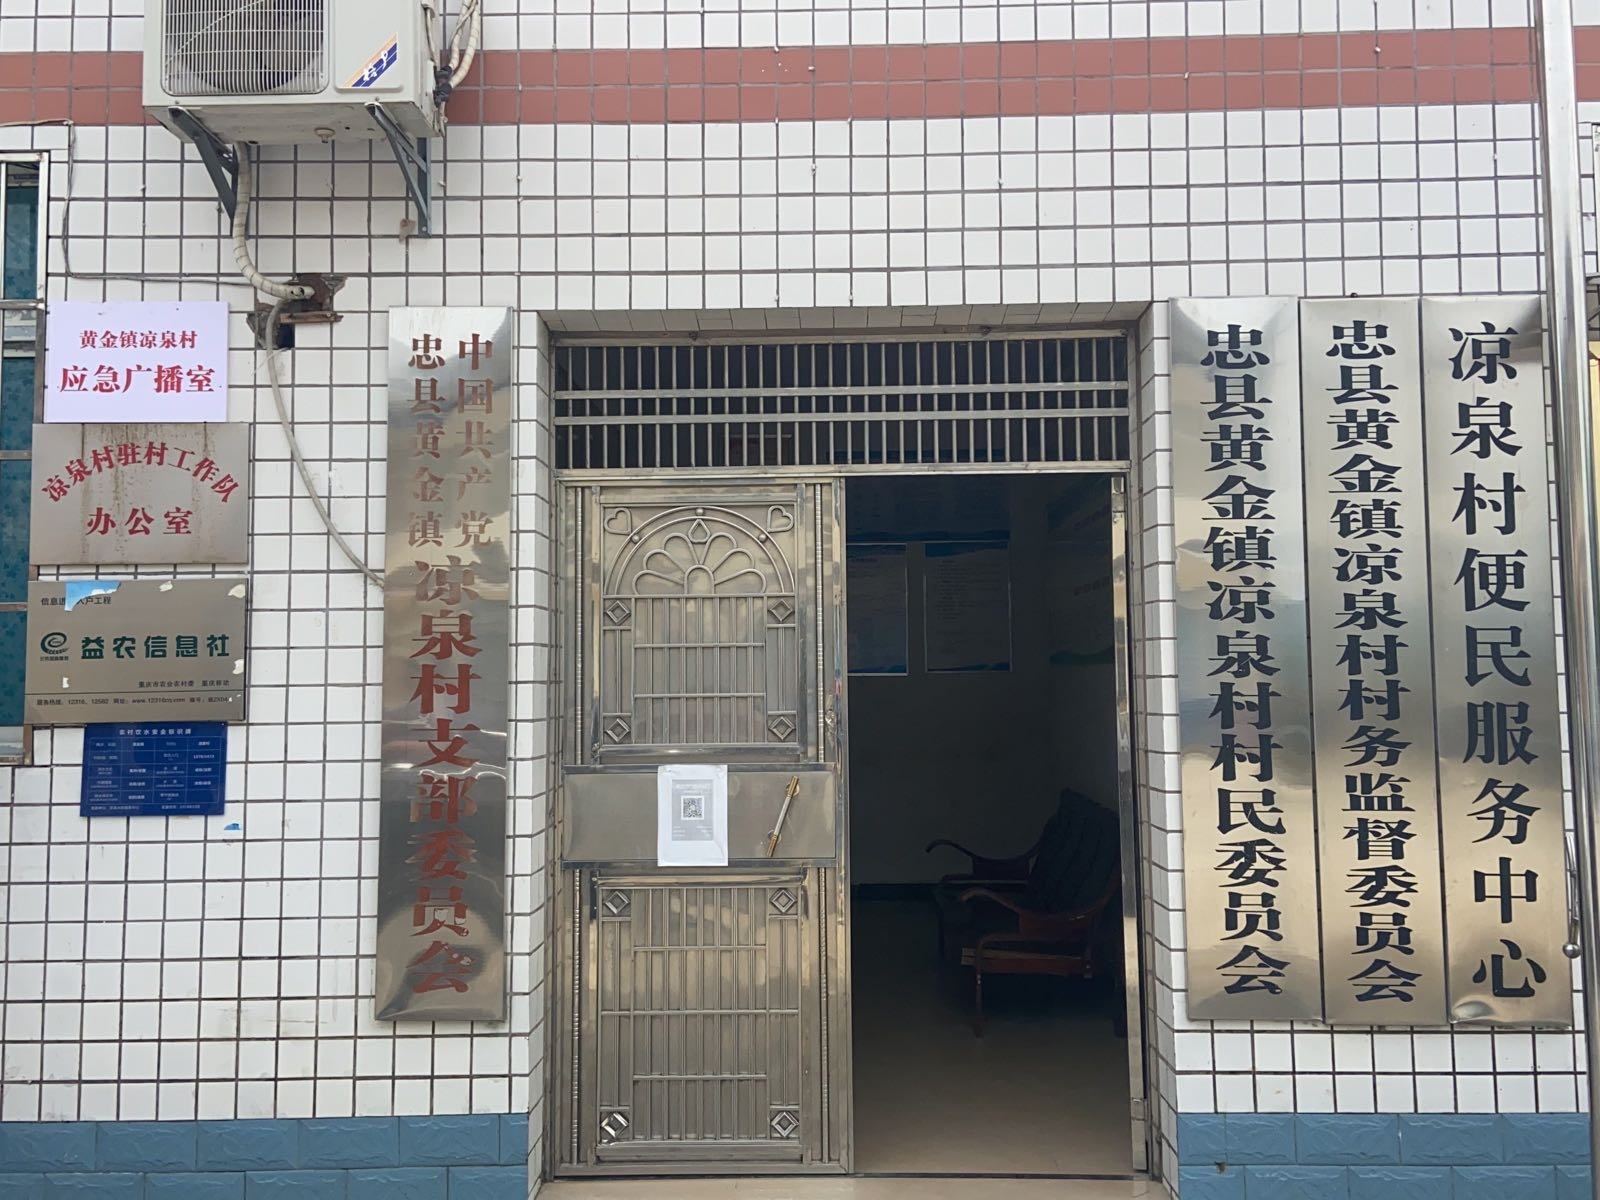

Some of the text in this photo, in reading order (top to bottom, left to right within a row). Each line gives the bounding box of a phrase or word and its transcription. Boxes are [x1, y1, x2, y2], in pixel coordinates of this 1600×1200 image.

[59, 363, 216, 394] 应急广播室
[79, 330, 198, 349] 黄金镇凉泉村
[406, 332, 447, 549] 忠县黄金镇
[454, 332, 495, 549] 中国共产党
[41, 441, 241, 504] 凉泉村驻村工作队
[86, 506, 193, 536] 办公室
[80, 633, 230, 660] 益农信息社
[1199, 323, 1291, 996] 忠县黄金镇凉泉村村民委员会
[1325, 319, 1424, 1003] 忠县黄金镇凉泉村村务监督委员会
[1448, 321, 1547, 999] 凉泉村便民服务中心
[404, 554, 484, 995] 凉泉村支部委员会
